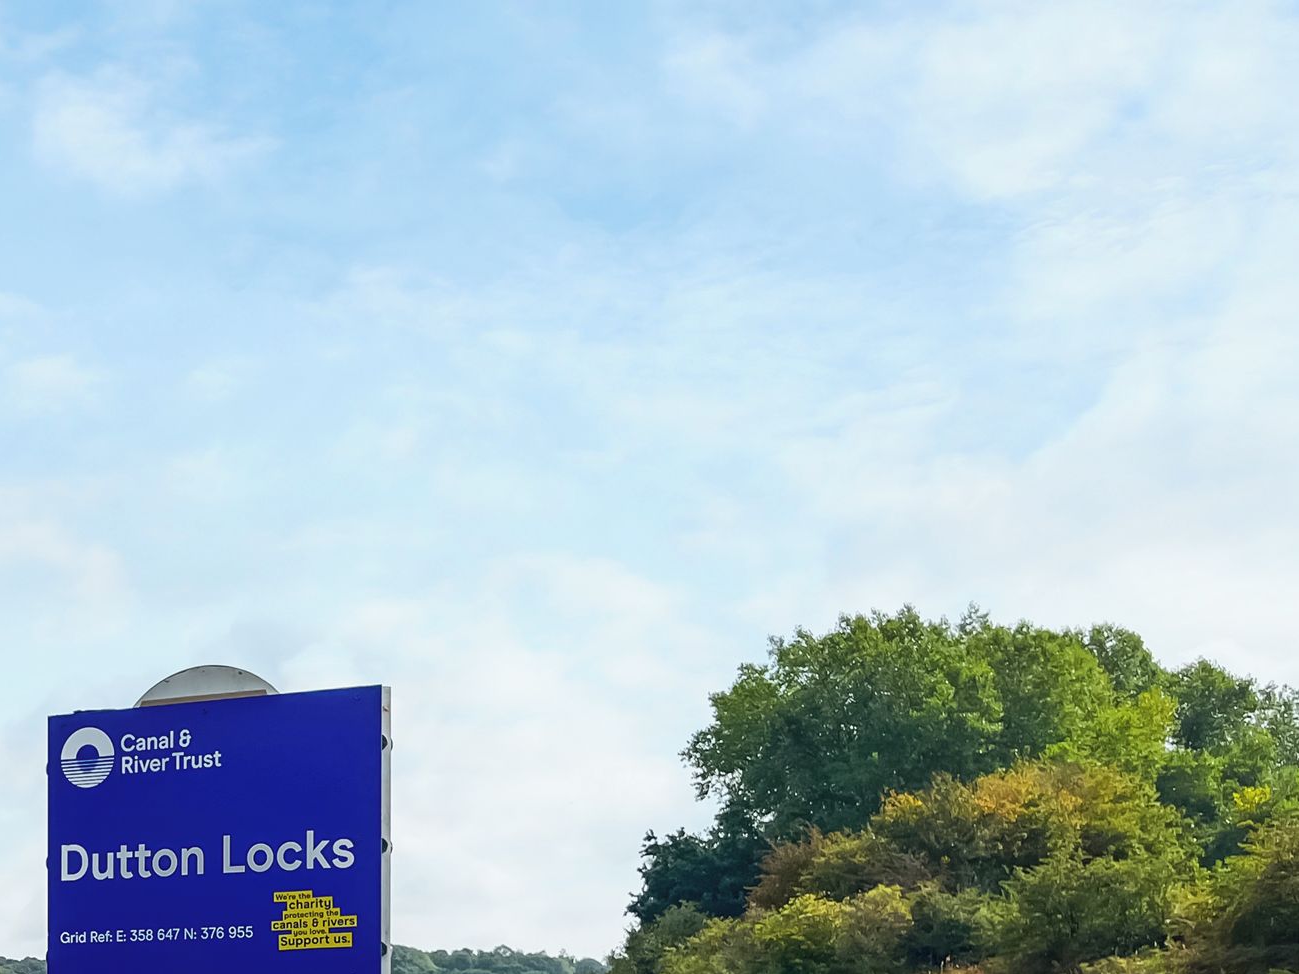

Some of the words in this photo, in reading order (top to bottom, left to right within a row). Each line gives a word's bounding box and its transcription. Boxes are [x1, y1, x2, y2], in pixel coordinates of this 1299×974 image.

[121, 731, 174, 752] Canal
[179, 729, 192, 747] &
[121, 754, 169, 774] River
[172, 750, 222, 769] Trust
[60, 844, 204, 882] Dutton
[223, 830, 355, 874] Locks
[289, 899, 331, 910] charity
[284, 911, 324, 920] protecting
[272, 919, 308, 930] canals
[311, 918, 319, 927] &
[322, 917, 355, 926] rivers
[60, 931, 86, 944] Grid
[90, 930, 113, 943] Ref:
[116, 930, 127, 942] E:
[130, 929, 154, 941] 358
[157, 928, 180, 940] 647
[184, 927, 197, 940] N:
[200, 926, 224, 939] 376
[228, 925, 253, 938] 955
[293, 929, 307, 937] you
[280, 935, 330, 947] Support
[333, 935, 351, 944] us.
